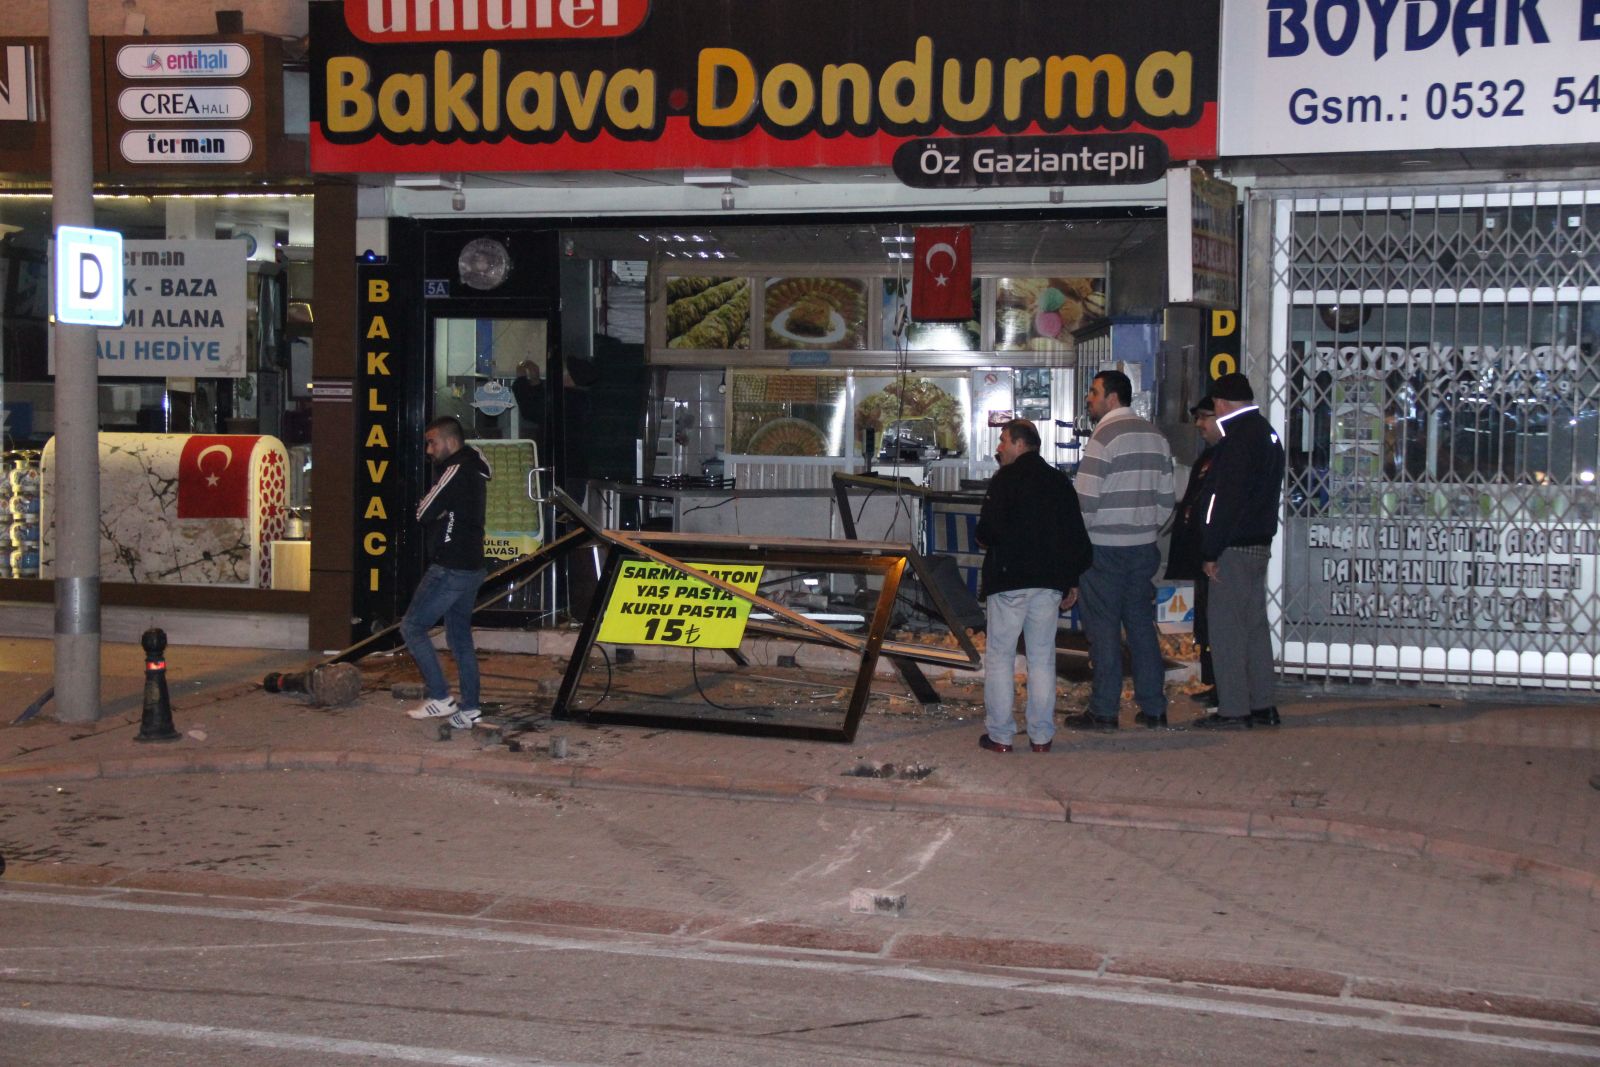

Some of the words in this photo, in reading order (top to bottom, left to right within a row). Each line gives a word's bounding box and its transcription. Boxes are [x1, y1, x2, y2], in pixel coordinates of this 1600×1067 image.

[1266, 0, 1551, 61] BOYDAK
[326, 48, 657, 133] Baklava
[696, 35, 1194, 127] Dondurma
[140, 93, 199, 115] CREA
[202, 103, 229, 114] HALI
[1426, 79, 1525, 120] 0532
[919, 144, 960, 175] Öz
[972, 144, 1145, 178] Gaziantepli
[79, 252, 104, 300] D
[160, 278, 218, 297] BAZA
[427, 282, 447, 295] 5A
[151, 309, 225, 328] ALANA
[135, 336, 220, 361] HEDİYE
[363, 279, 392, 592] BAKLAVACI
[1378, 525, 1421, 550] ALM
[623, 566, 689, 581] SARMA
[706, 570, 759, 584] ATON
[637, 585, 670, 599] YAŞ
[675, 586, 734, 601] PASTA
[620, 602, 673, 616] KURU
[677, 604, 737, 619] PASTA
